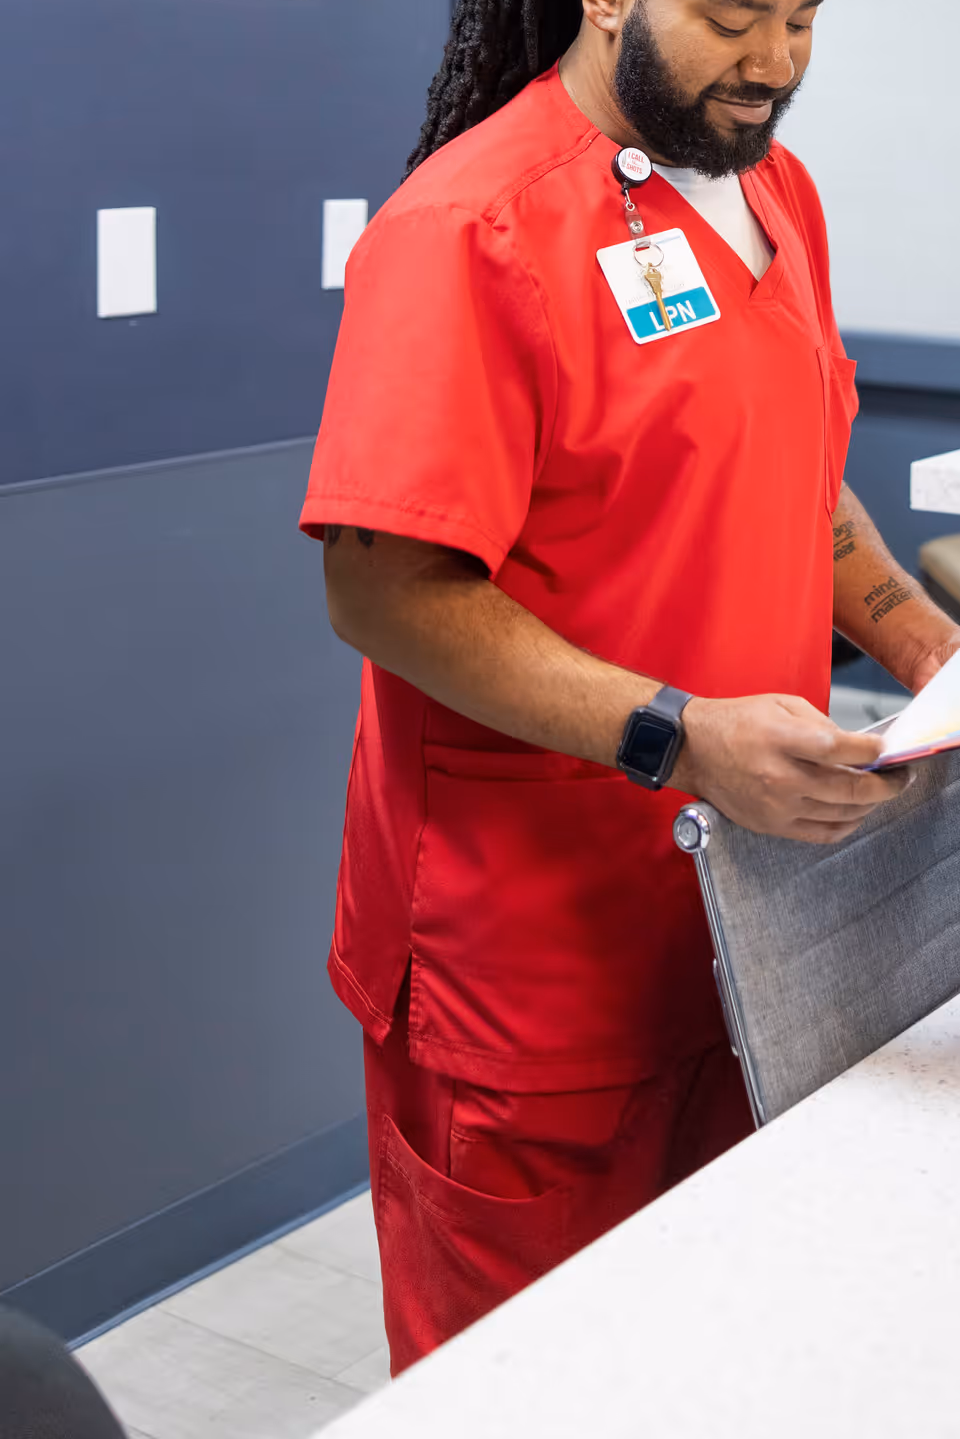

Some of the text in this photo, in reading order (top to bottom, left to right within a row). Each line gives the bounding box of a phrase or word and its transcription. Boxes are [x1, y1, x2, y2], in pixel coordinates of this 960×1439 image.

[631, 153, 644, 163] CALL
[626, 163, 643, 174] SHOTS
[648, 299, 697, 331] LPN
[864, 576, 900, 606] mind
